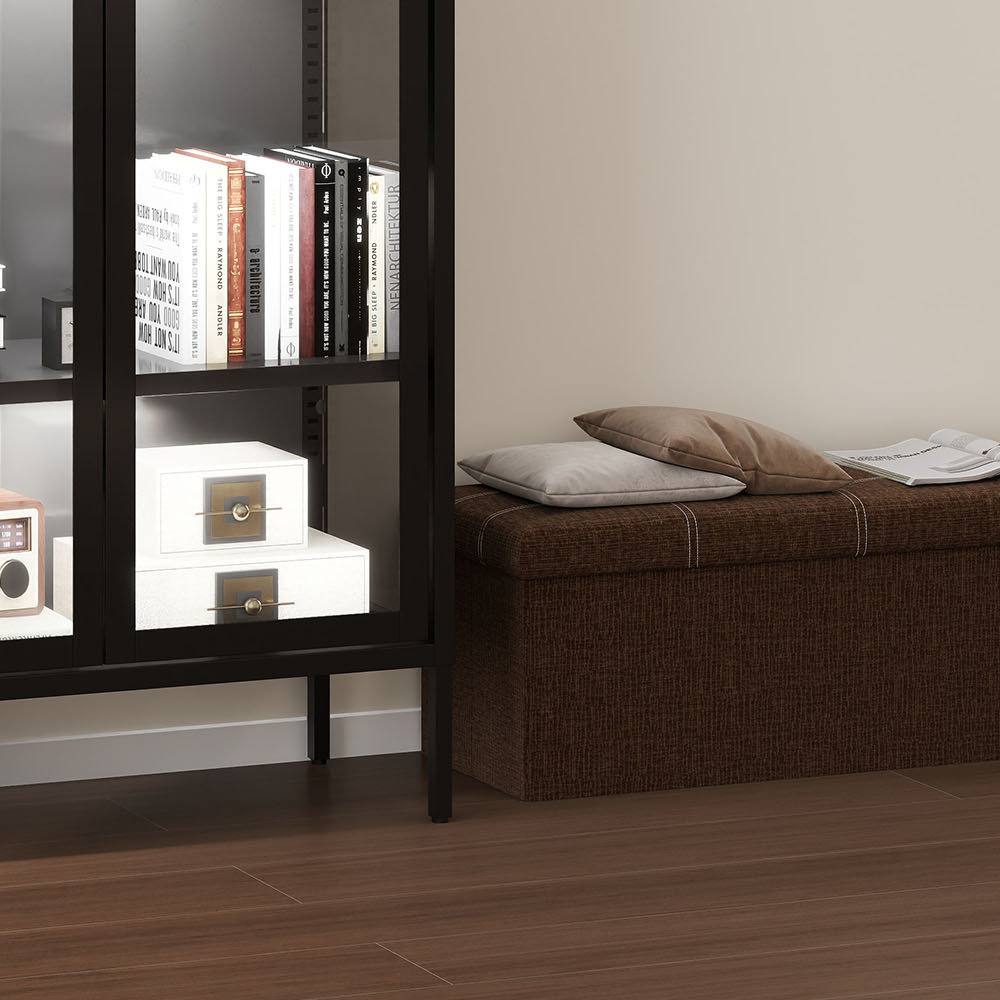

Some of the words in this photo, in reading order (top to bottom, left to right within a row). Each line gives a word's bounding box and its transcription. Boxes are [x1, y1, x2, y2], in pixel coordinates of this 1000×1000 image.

[150, 256, 167, 279] WANT
[168, 260, 180, 283] YOU
[153, 280, 166, 302] HOW
[168, 284, 180, 306] IT'S
[250, 258, 262, 313] architecture
[149, 302, 161, 324] YOU
[164, 306, 180, 330] GOOD
[138, 322, 152, 344] HOW
[154, 326, 166, 350] NOT
[168, 331, 180, 354] IT'S
